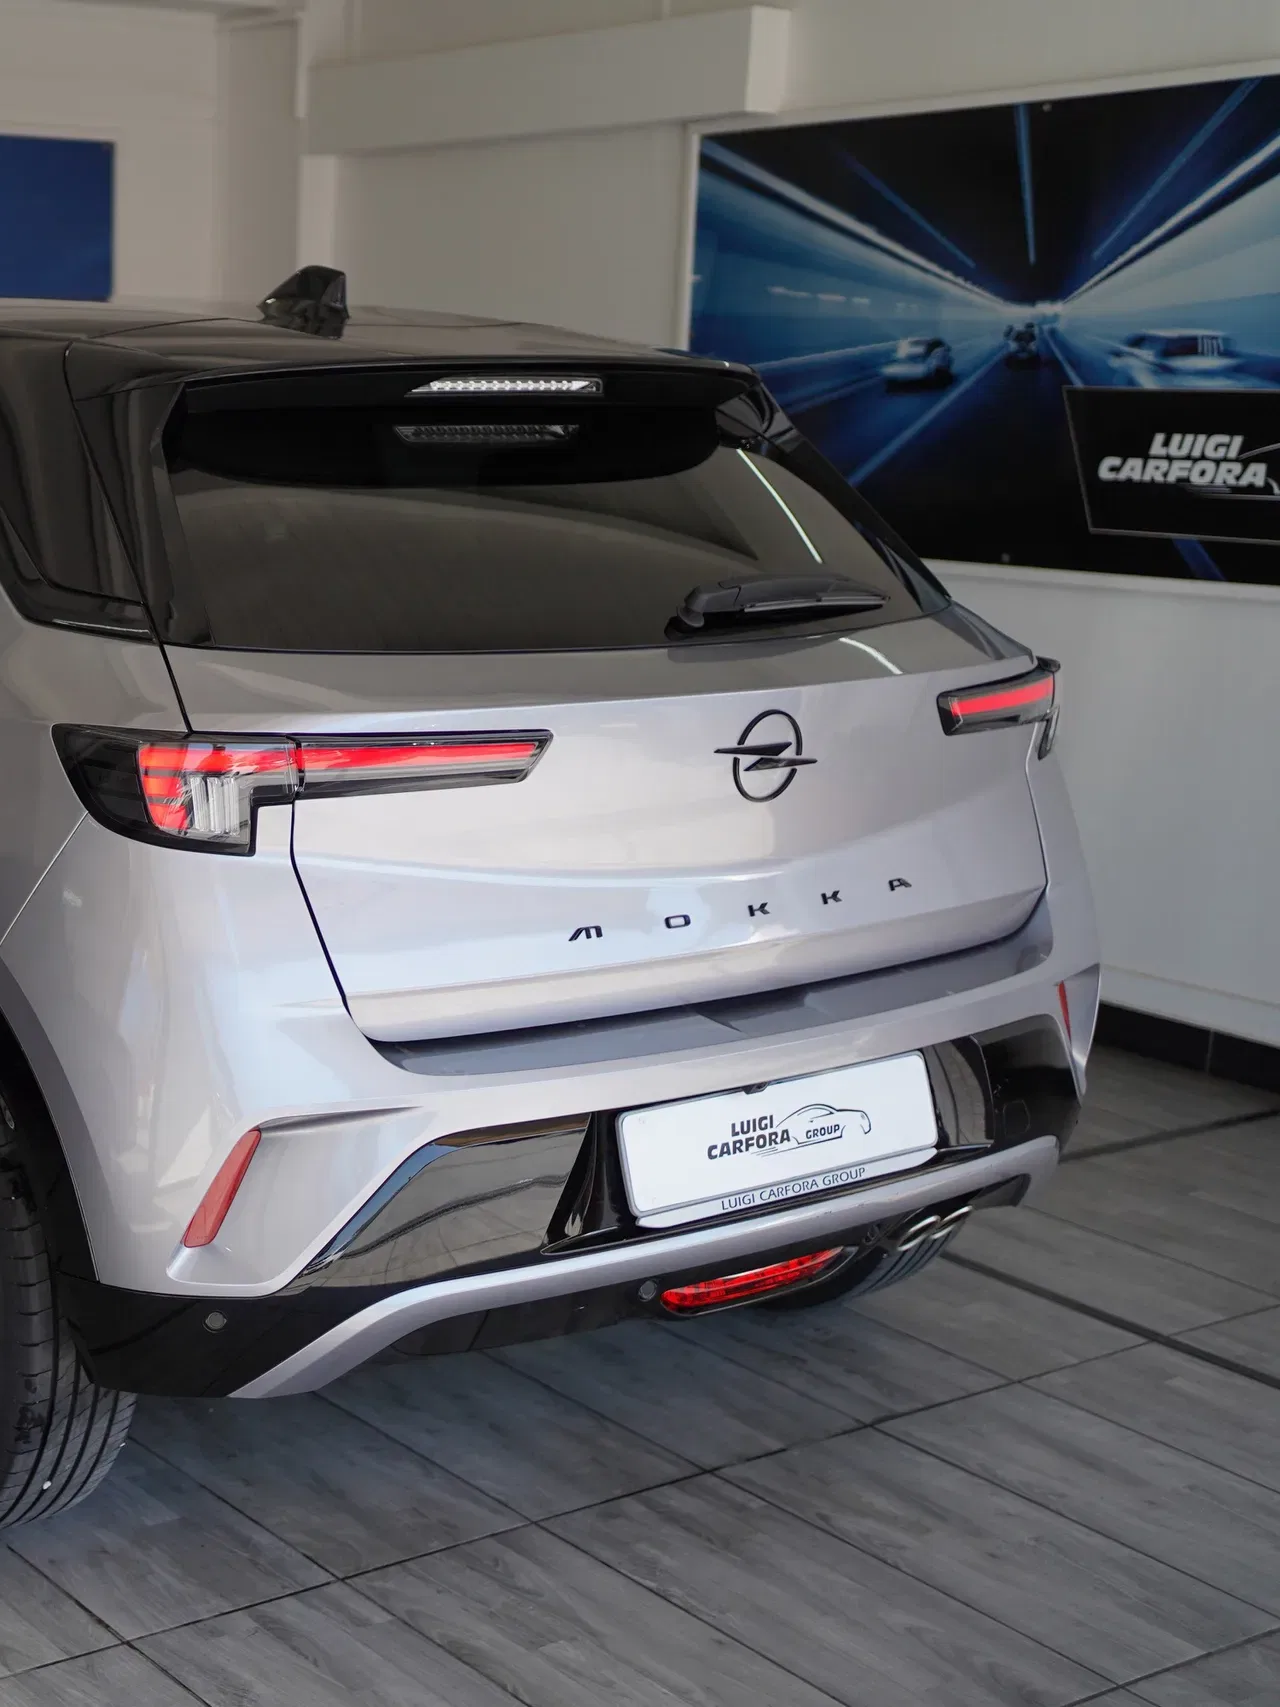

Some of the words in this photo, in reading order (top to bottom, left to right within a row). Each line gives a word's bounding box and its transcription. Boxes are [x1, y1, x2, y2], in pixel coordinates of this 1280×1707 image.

[1148, 432, 1244, 460] LUIGI
[1098, 456, 1268, 488] CARFORA
[568, 877, 913, 942] MOKKA
[707, 1128, 791, 1160] CARFORA
[805, 1123, 841, 1140] GROUP
[731, 1114, 774, 1137] LUIGI
[721, 1193, 756, 1211] LUIGI
[759, 1179, 819, 1202] CARFORA
[822, 1166, 866, 1187] GROUP
